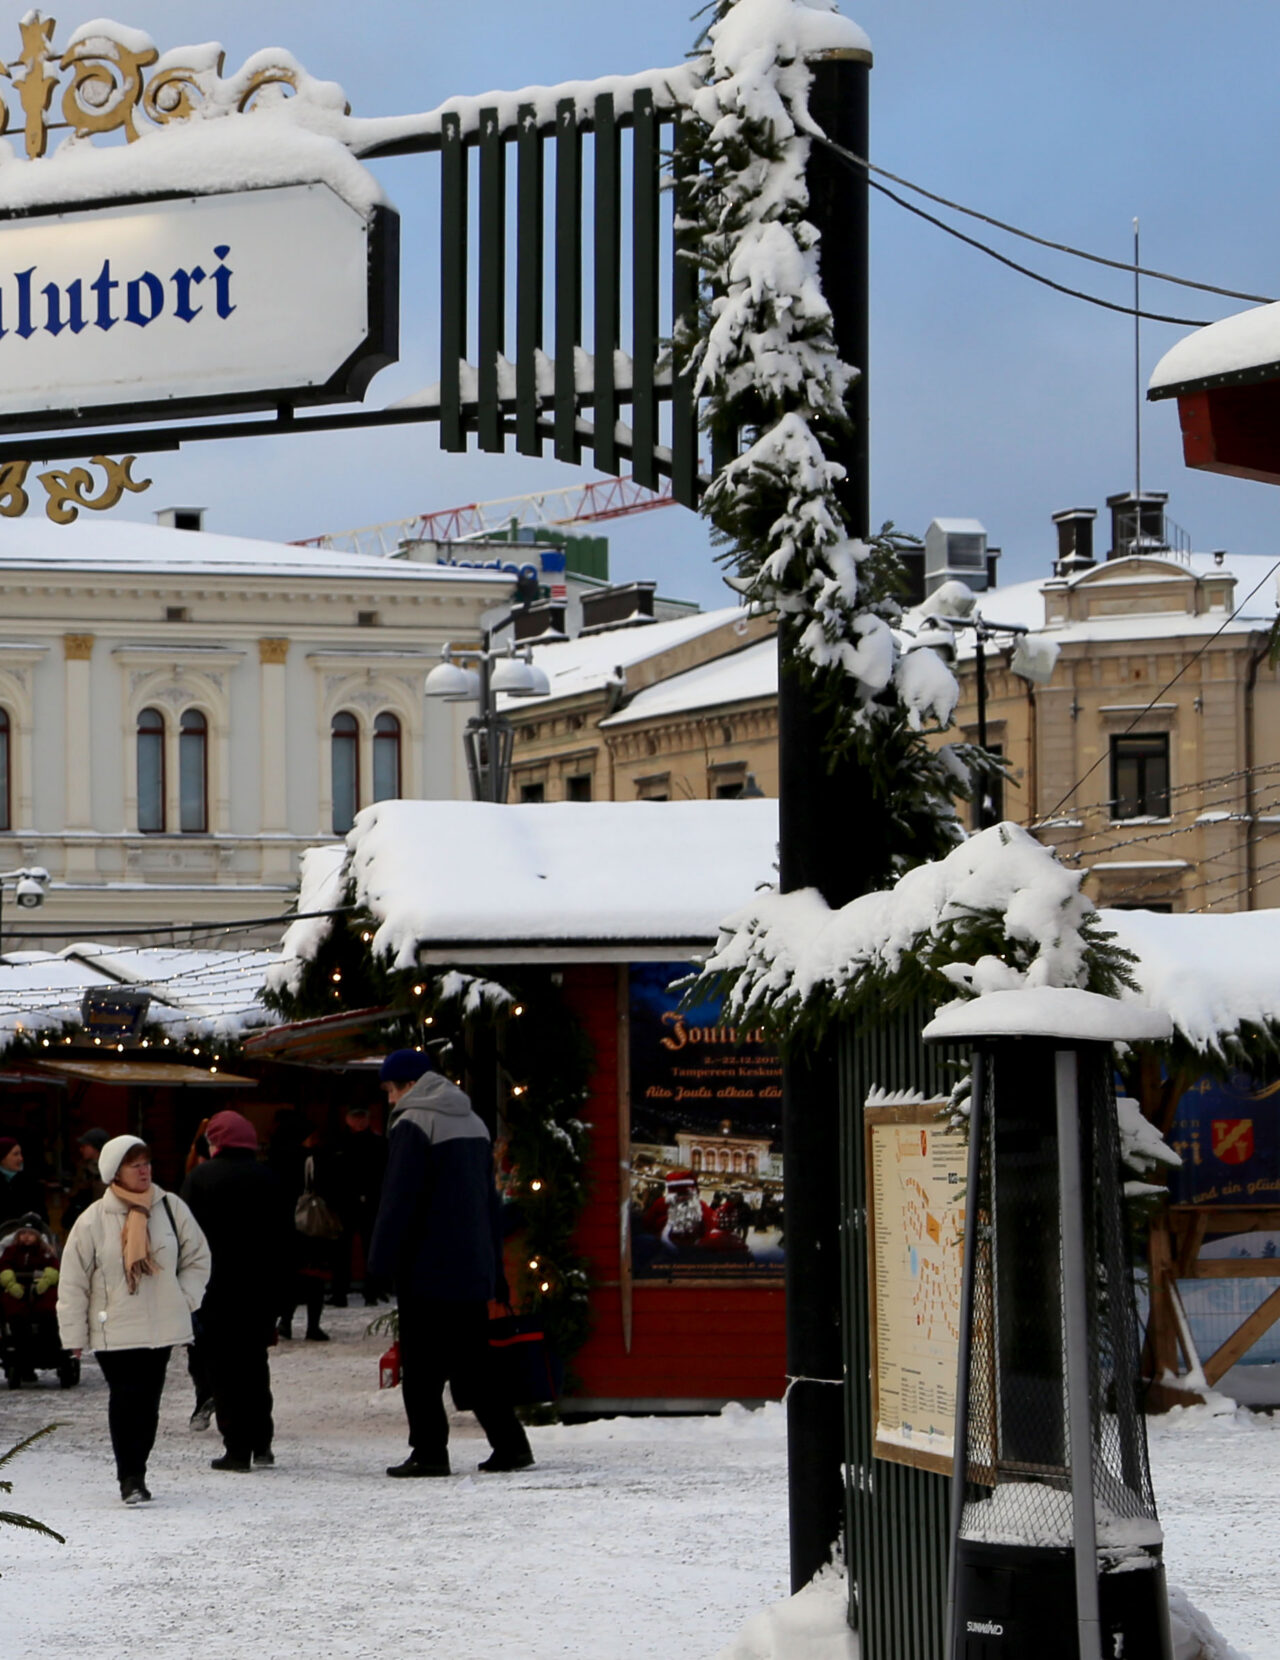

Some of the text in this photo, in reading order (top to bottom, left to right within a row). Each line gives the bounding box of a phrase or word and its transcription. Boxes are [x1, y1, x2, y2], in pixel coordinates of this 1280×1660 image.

[671, 1067, 736, 1080] Tampereen
[645, 1085, 673, 1098] Aito
[674, 1085, 713, 1101] Joulu
[716, 1085, 755, 1098] alkaa
